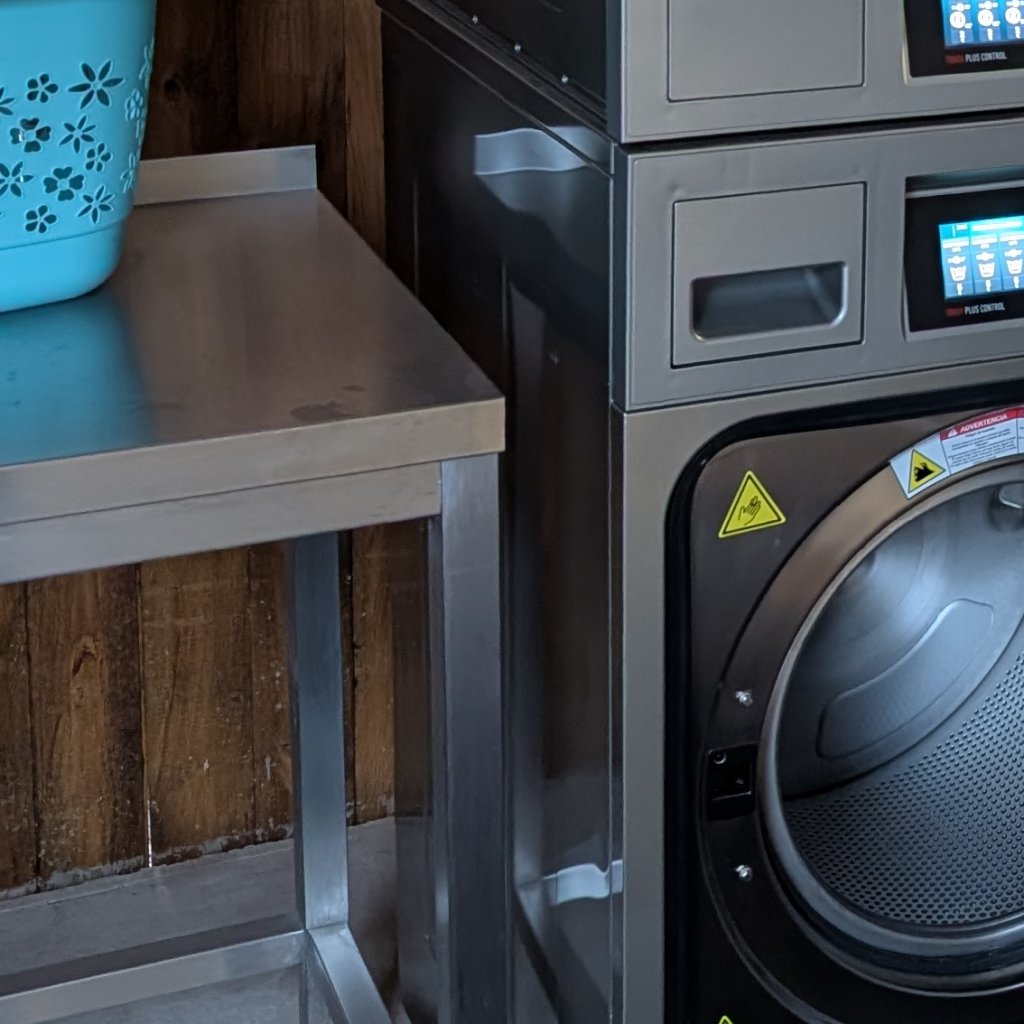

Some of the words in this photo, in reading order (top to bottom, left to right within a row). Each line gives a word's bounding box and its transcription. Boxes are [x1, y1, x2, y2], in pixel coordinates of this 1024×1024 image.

[965, 53, 980, 62] PLUS
[980, 51, 1007, 61] CONTROL
[964, 305, 979, 315] PLUS
[980, 302, 1006, 313] CONTROL
